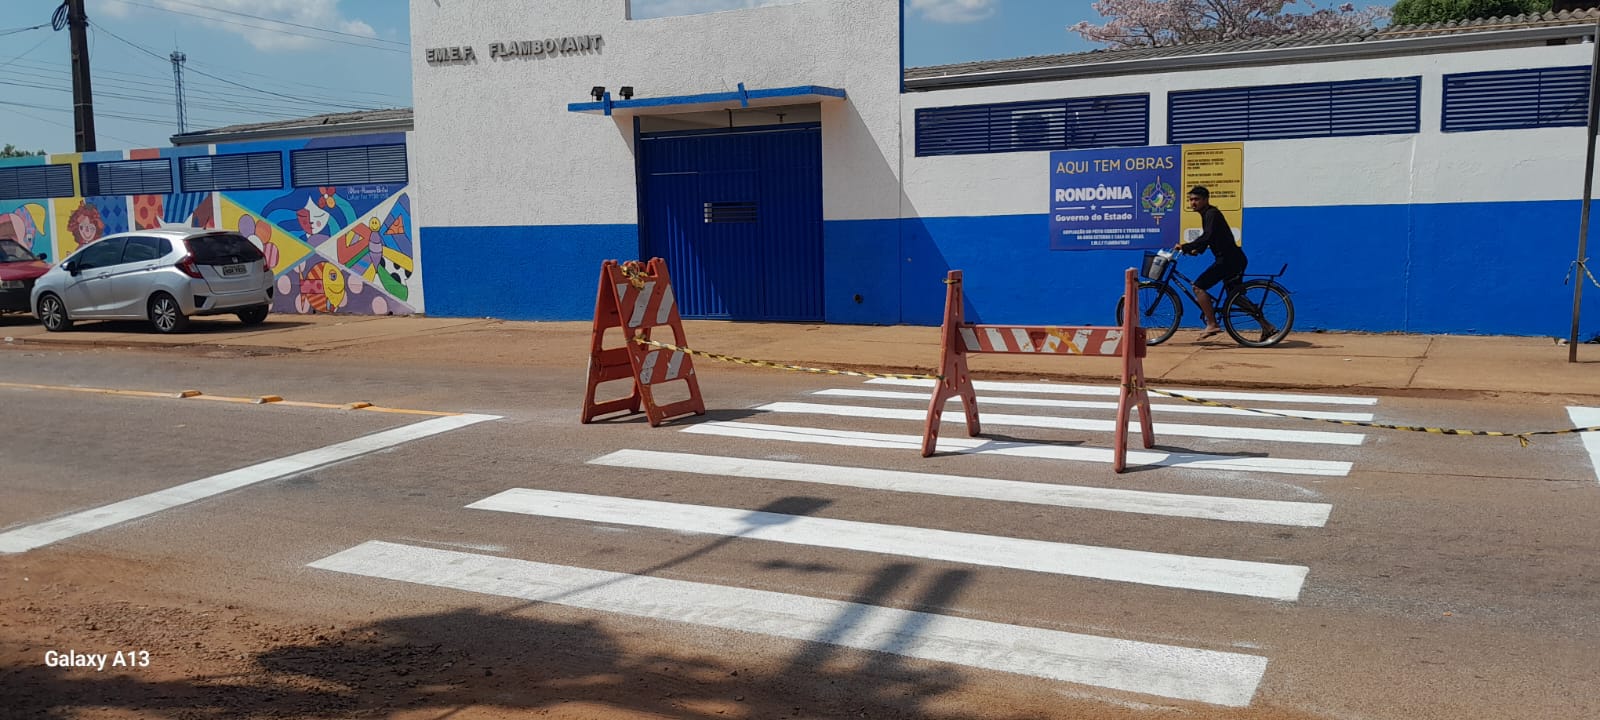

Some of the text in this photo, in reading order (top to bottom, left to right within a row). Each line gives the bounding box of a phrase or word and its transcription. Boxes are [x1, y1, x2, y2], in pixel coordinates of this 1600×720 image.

[488, 35, 604, 58] FLAMBOYANT
[1056, 161, 1089, 174] AQUI
[1093, 159, 1121, 172] TEM
[1125, 156, 1174, 171] OBRAS
[1055, 183, 1133, 202] RONDÔNIA
[1055, 212, 1133, 222] Governo do Estado
